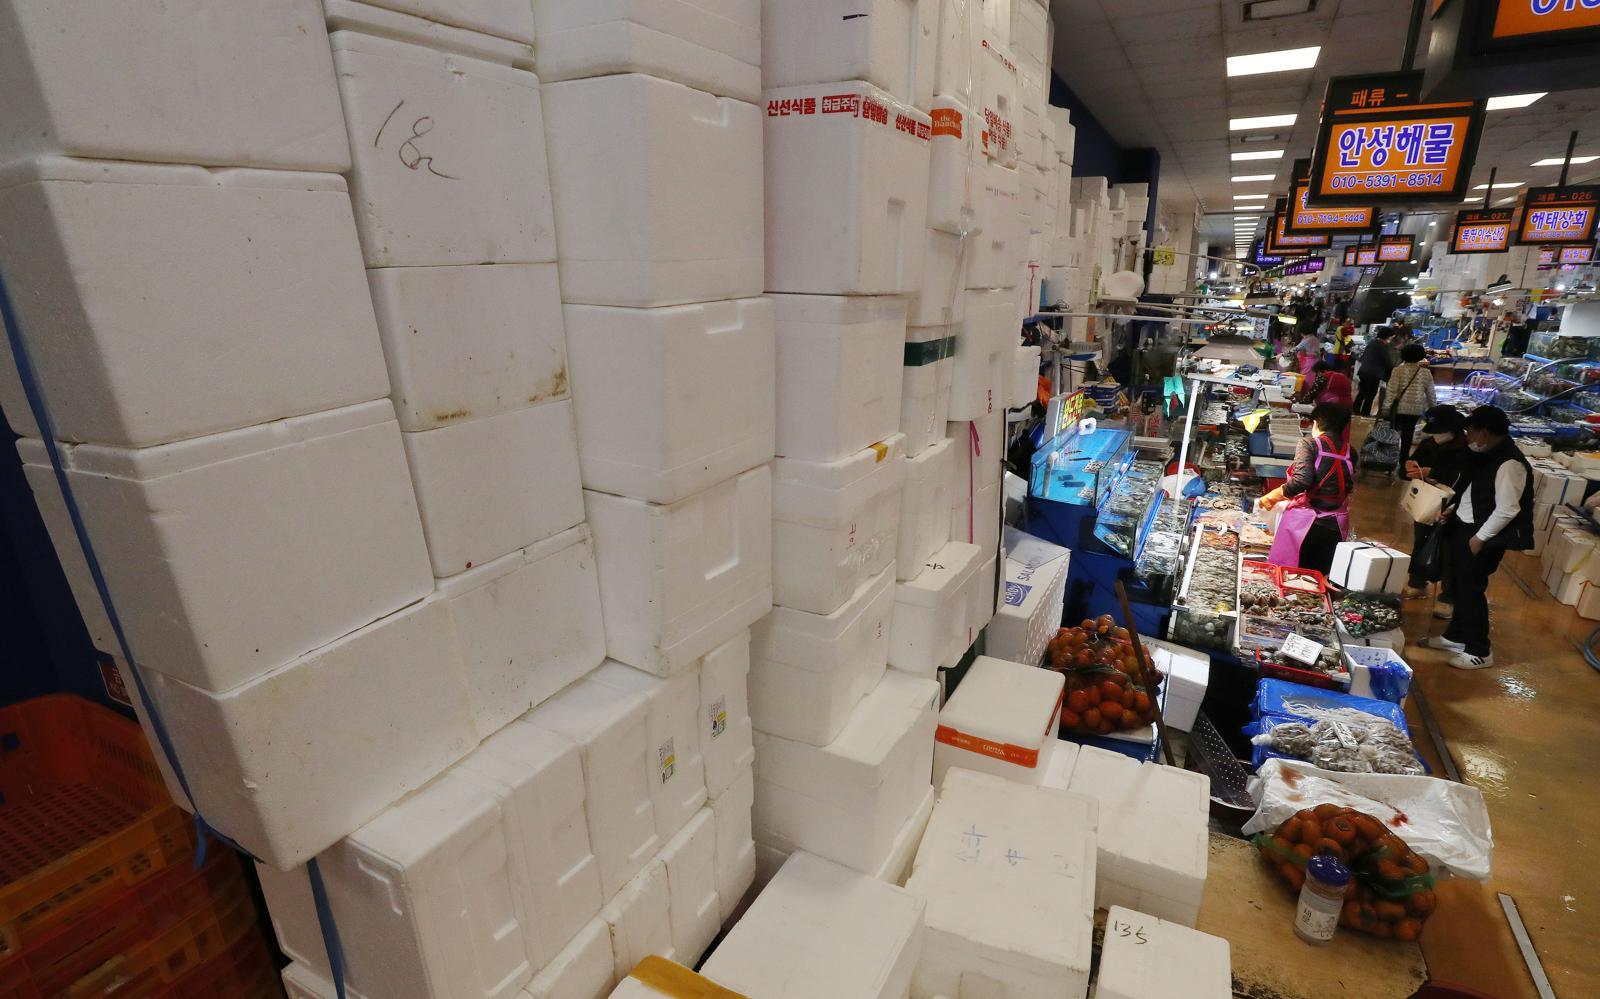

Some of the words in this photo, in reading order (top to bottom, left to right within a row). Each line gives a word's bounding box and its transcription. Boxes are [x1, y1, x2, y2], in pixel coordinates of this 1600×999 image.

[1351, 88, 1385, 107] 패류
[767, 98, 816, 117] 신선식품
[1339, 123, 1454, 167] 안성해물
[1331, 172, 1443, 189] 010-5391-8514
[1531, 210, 1589, 230] 해태상회
[1114, 919, 1148, 945] 135
